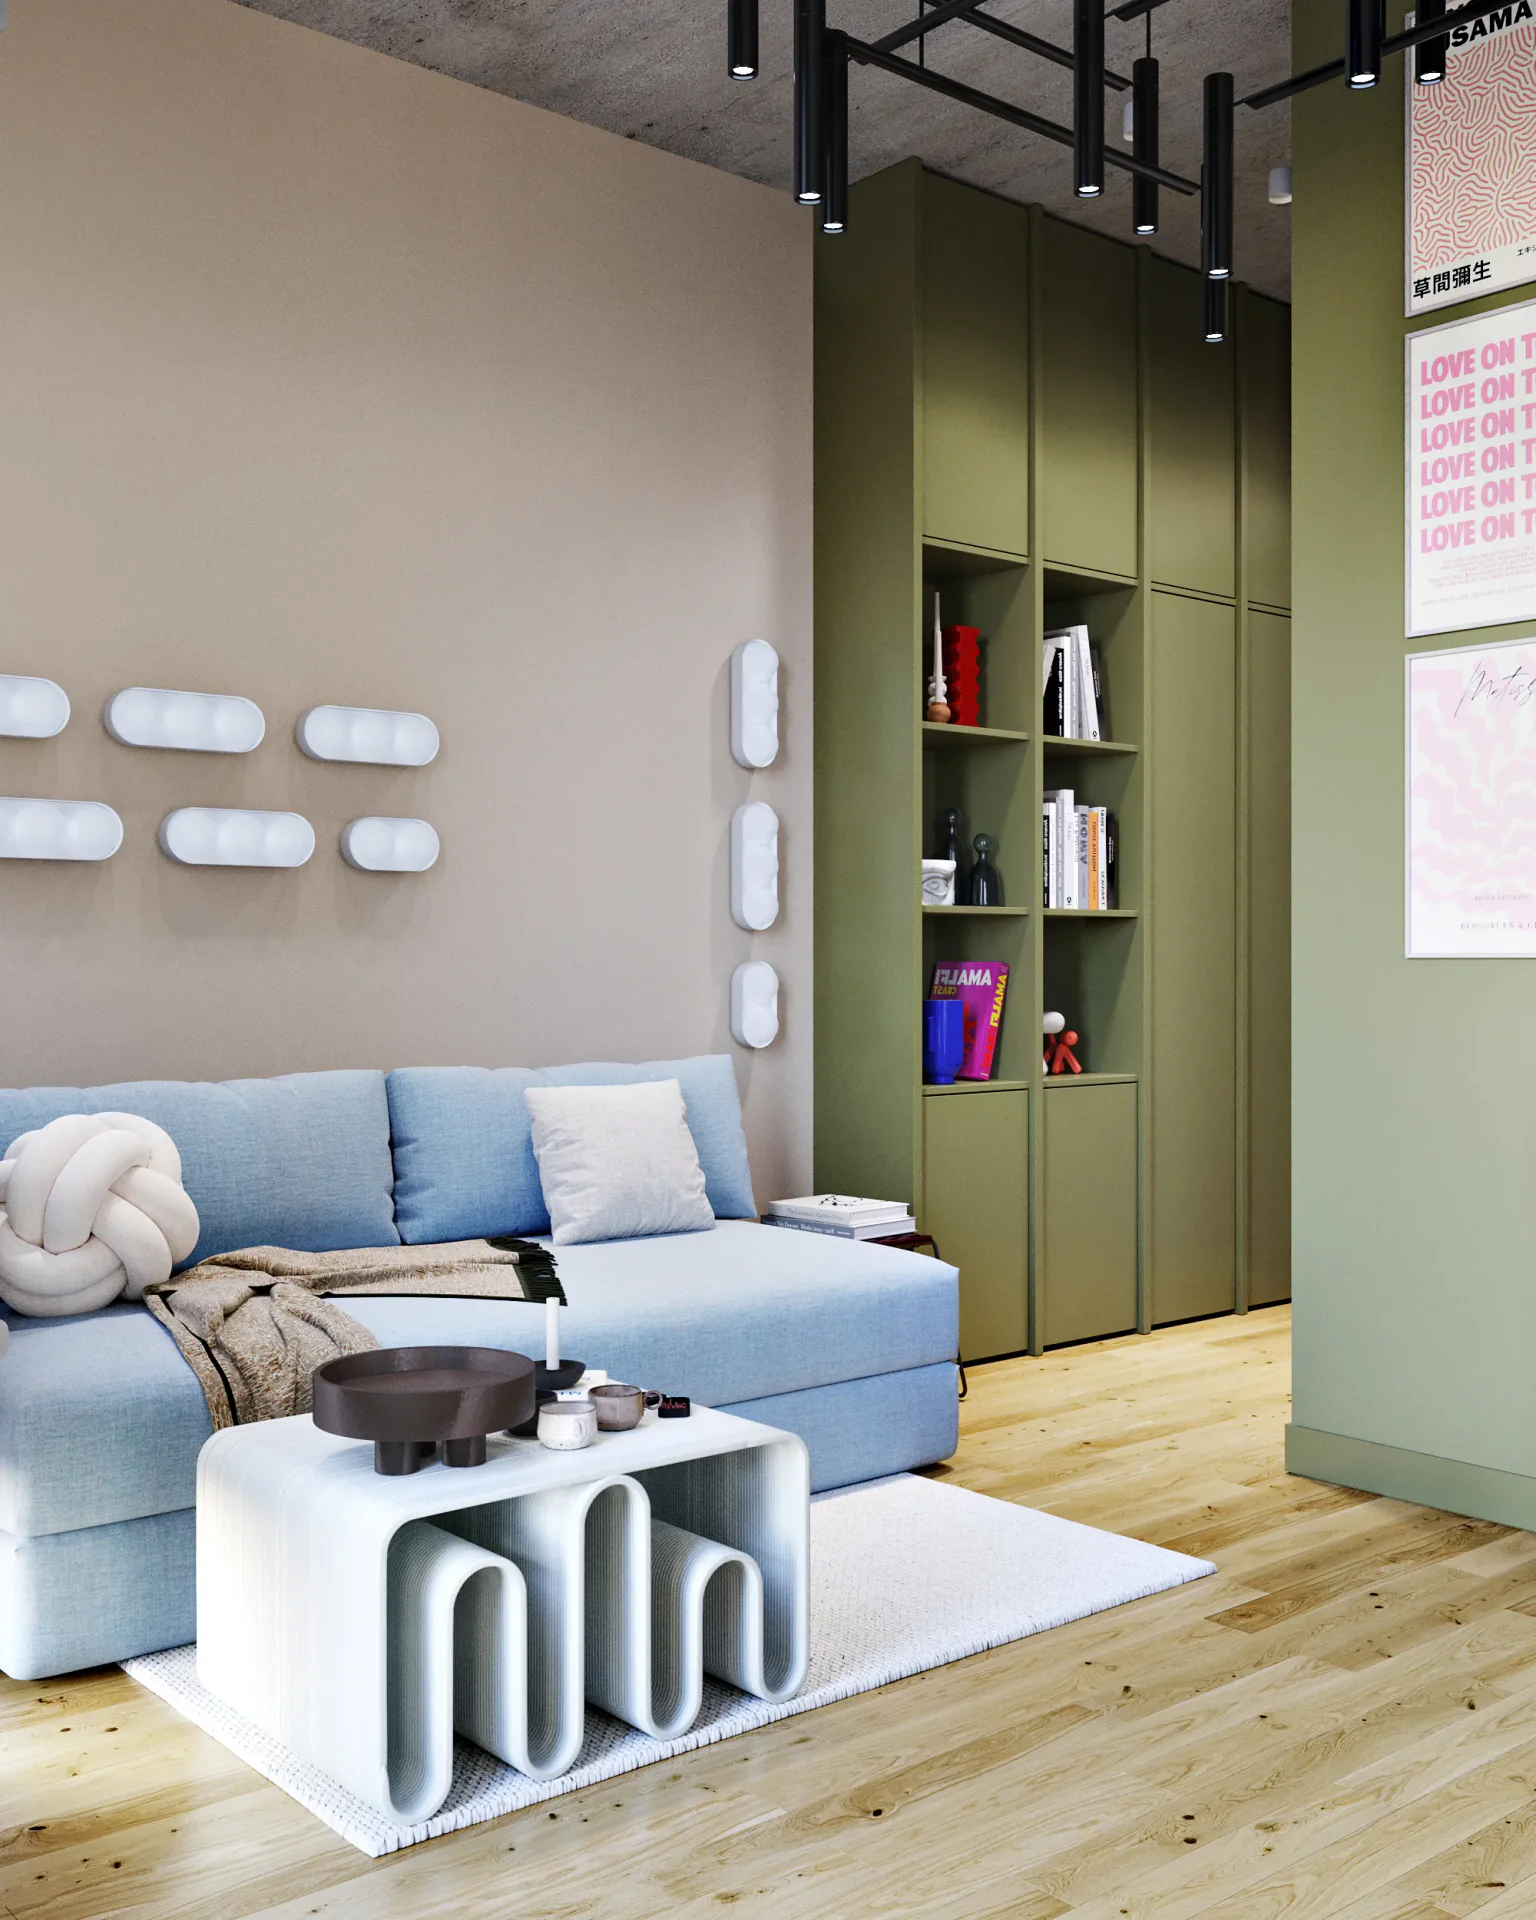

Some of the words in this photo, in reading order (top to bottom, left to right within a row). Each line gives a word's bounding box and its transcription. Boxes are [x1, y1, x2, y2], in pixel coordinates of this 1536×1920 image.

[1445, 0, 1533, 51] SAMA
[1413, 260, 1492, 298] 草間彌生
[1421, 348, 1475, 386] LOVE
[1481, 337, 1515, 370] ON
[1521, 332, 1536, 360] T
[1421, 382, 1475, 420] LOVE
[1481, 372, 1515, 404] ON
[1521, 367, 1536, 395] T
[1421, 416, 1475, 453] LOVE
[1481, 407, 1515, 438] ON
[1521, 402, 1536, 430] T
[1421, 450, 1475, 487] LOVE
[1481, 442, 1515, 473] ON
[1521, 437, 1536, 465] T
[1421, 485, 1475, 520] LOVE
[1481, 476, 1515, 508] ON
[1521, 472, 1536, 500] T
[1421, 519, 1475, 554] LOVE
[1481, 511, 1515, 542] ON
[1521, 507, 1536, 535] T
